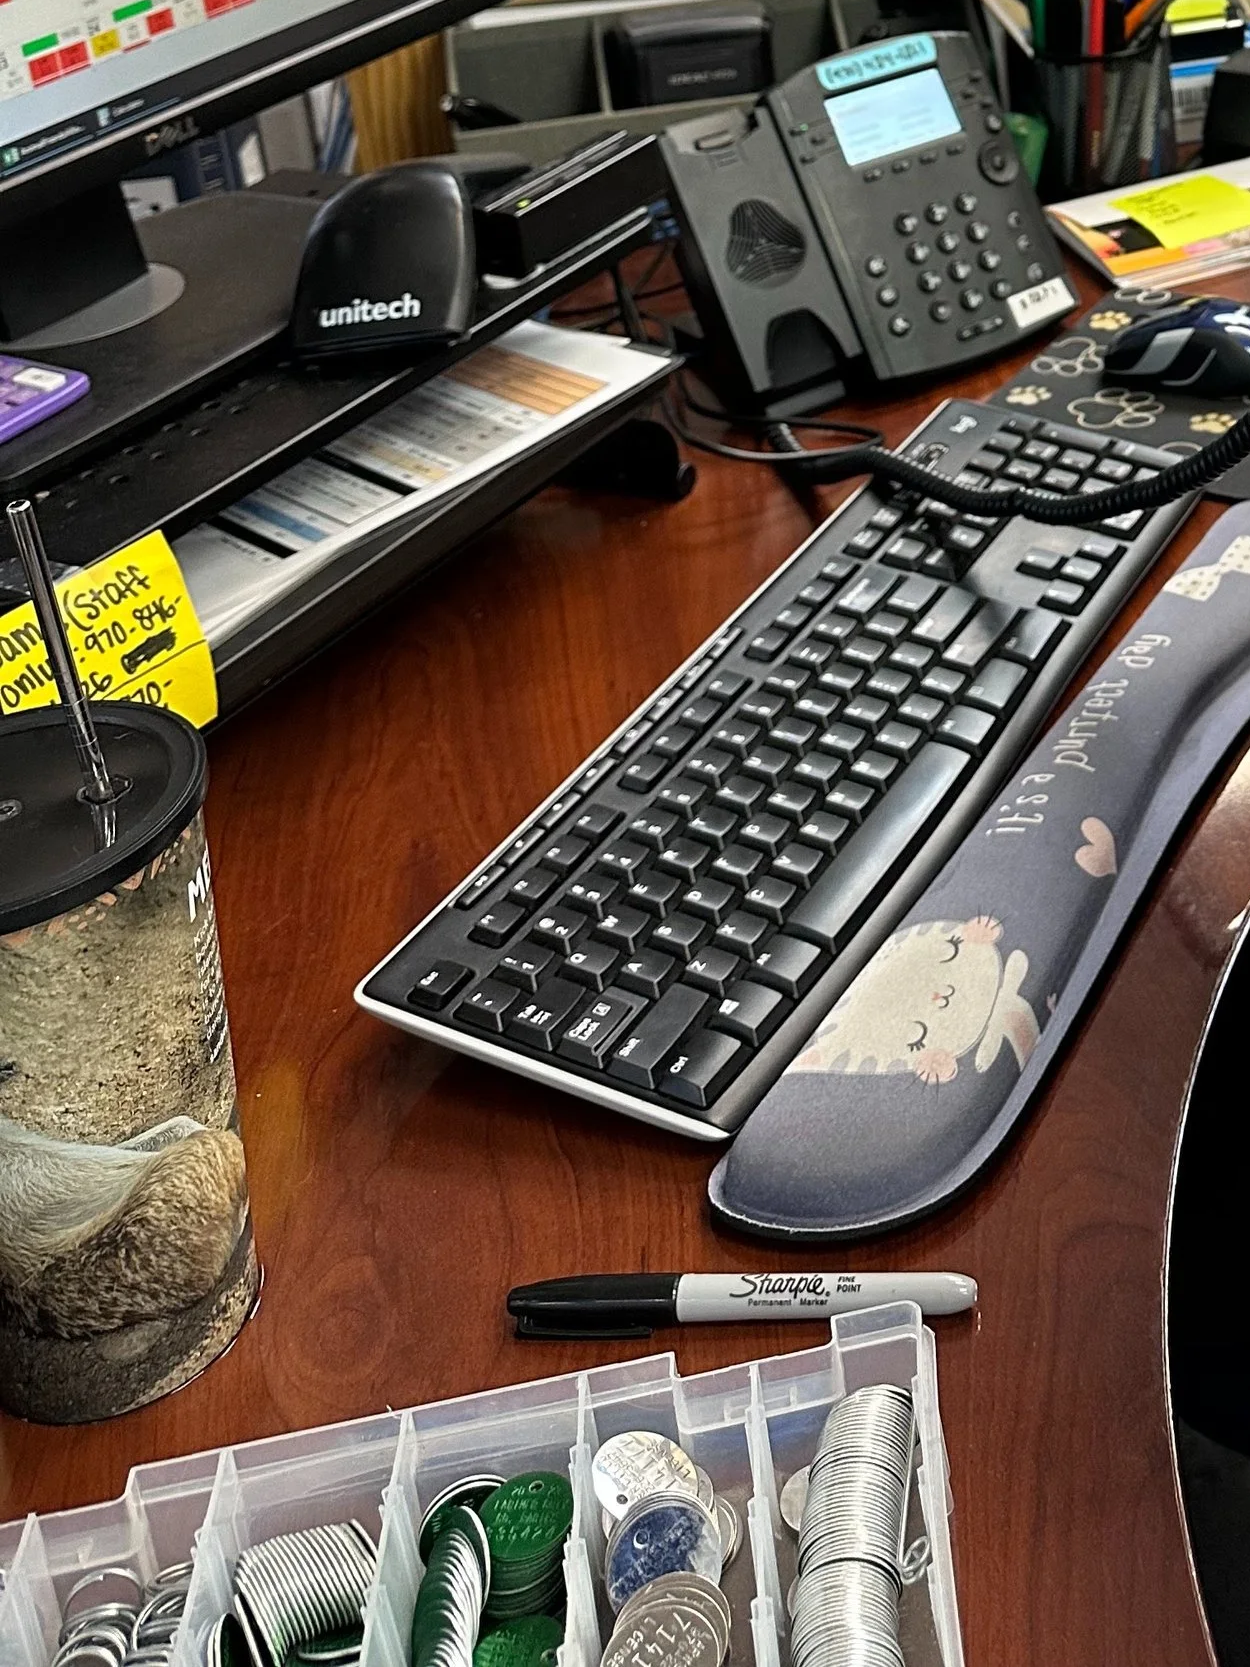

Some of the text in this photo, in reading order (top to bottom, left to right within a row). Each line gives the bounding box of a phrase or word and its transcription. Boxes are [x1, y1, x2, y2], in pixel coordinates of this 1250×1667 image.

[319, 292, 421, 328] unitech
[63, 565, 151, 631] (Staff
[729, 1273, 856, 1299] Sharpie FINE
[836, 1283, 862, 1293] POINT
[747, 1297, 829, 1307] Permanent Marker
